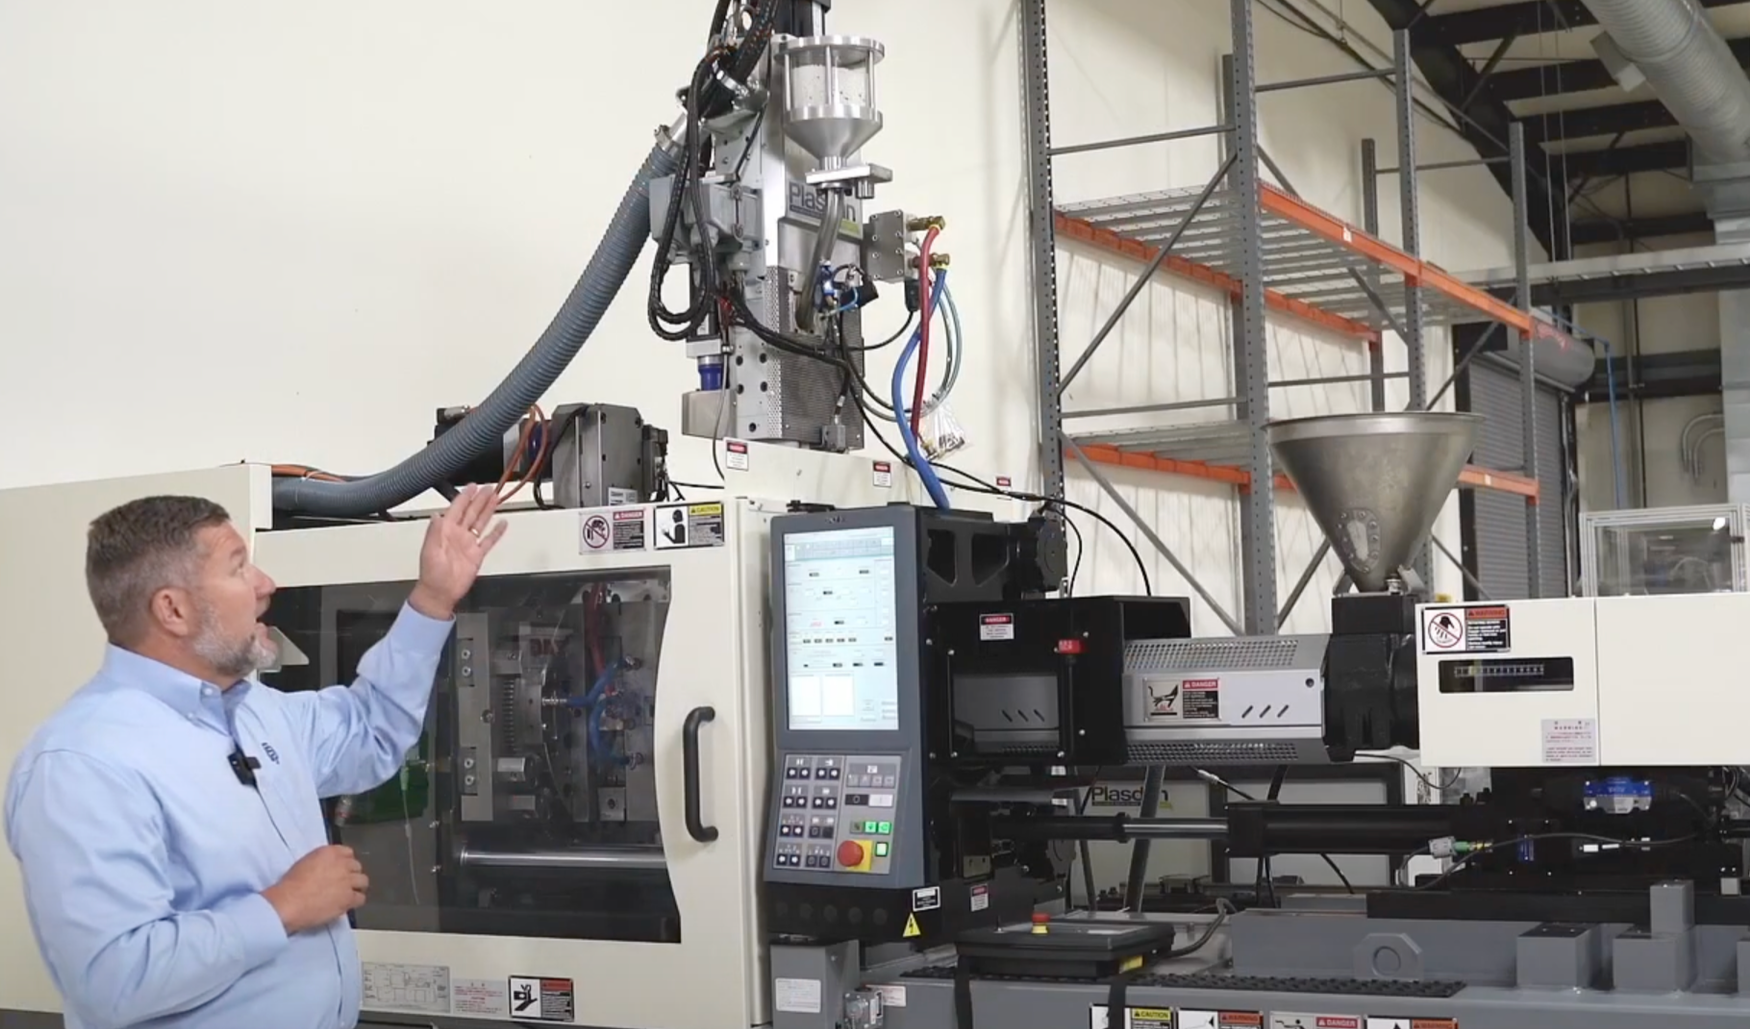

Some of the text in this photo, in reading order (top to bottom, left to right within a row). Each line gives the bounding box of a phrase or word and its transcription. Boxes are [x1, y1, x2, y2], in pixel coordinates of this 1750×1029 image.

[788, 181, 857, 222] Plasn
[620, 511, 643, 519] DANGER
[1091, 786, 1169, 801] Plasdn
[1326, 1019, 1356, 1028] DANGER
